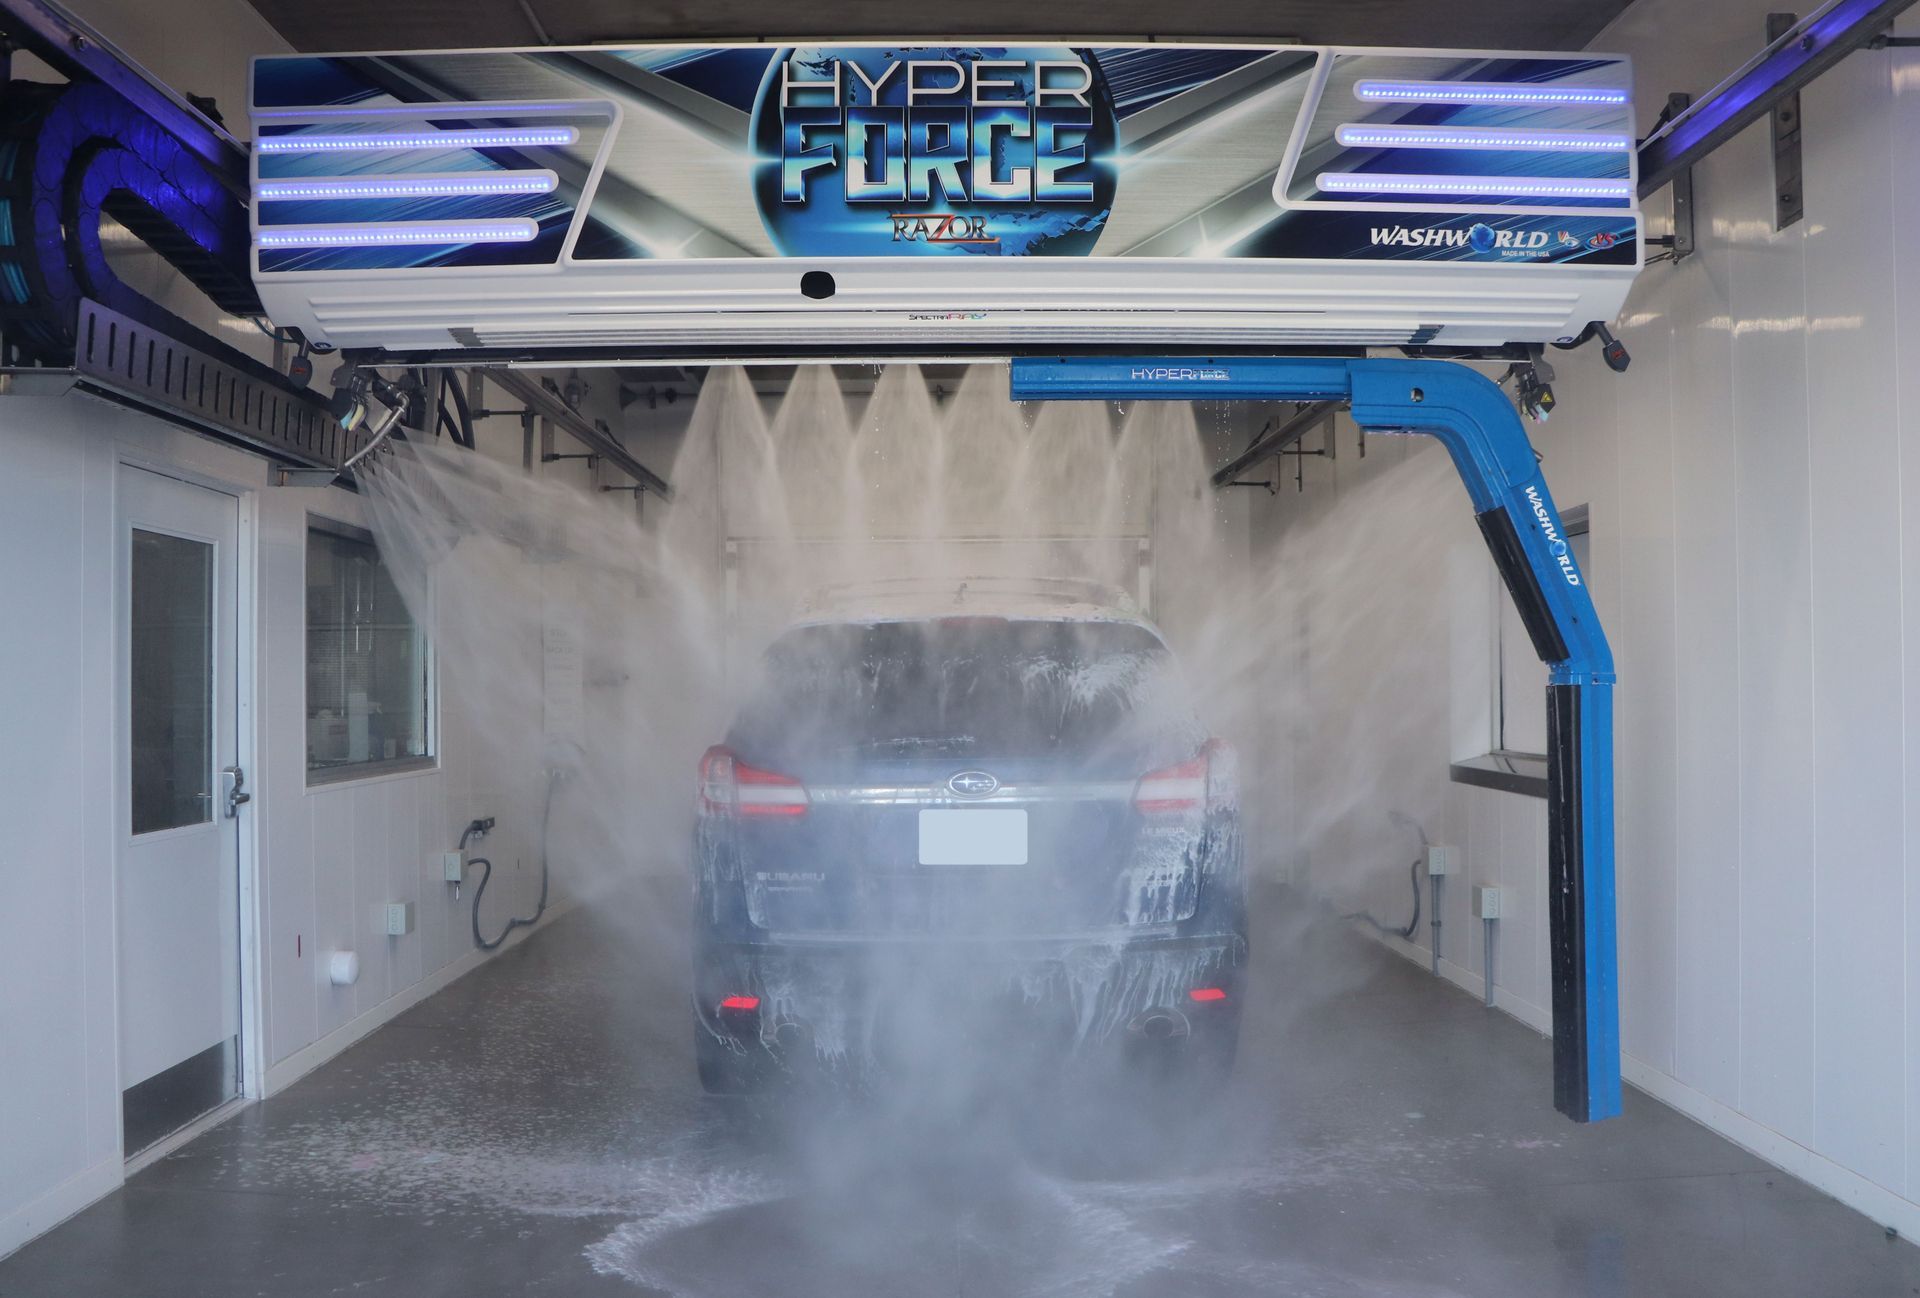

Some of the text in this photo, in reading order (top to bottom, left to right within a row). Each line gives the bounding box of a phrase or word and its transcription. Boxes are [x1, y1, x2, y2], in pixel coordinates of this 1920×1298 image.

[782, 60, 1093, 106] HYPER
[782, 106, 1094, 202] FORCE
[888, 214, 999, 243] RAZOR
[1370, 223, 1549, 253] WASHWORLD
[1525, 486, 1580, 586] WASHWORLD
